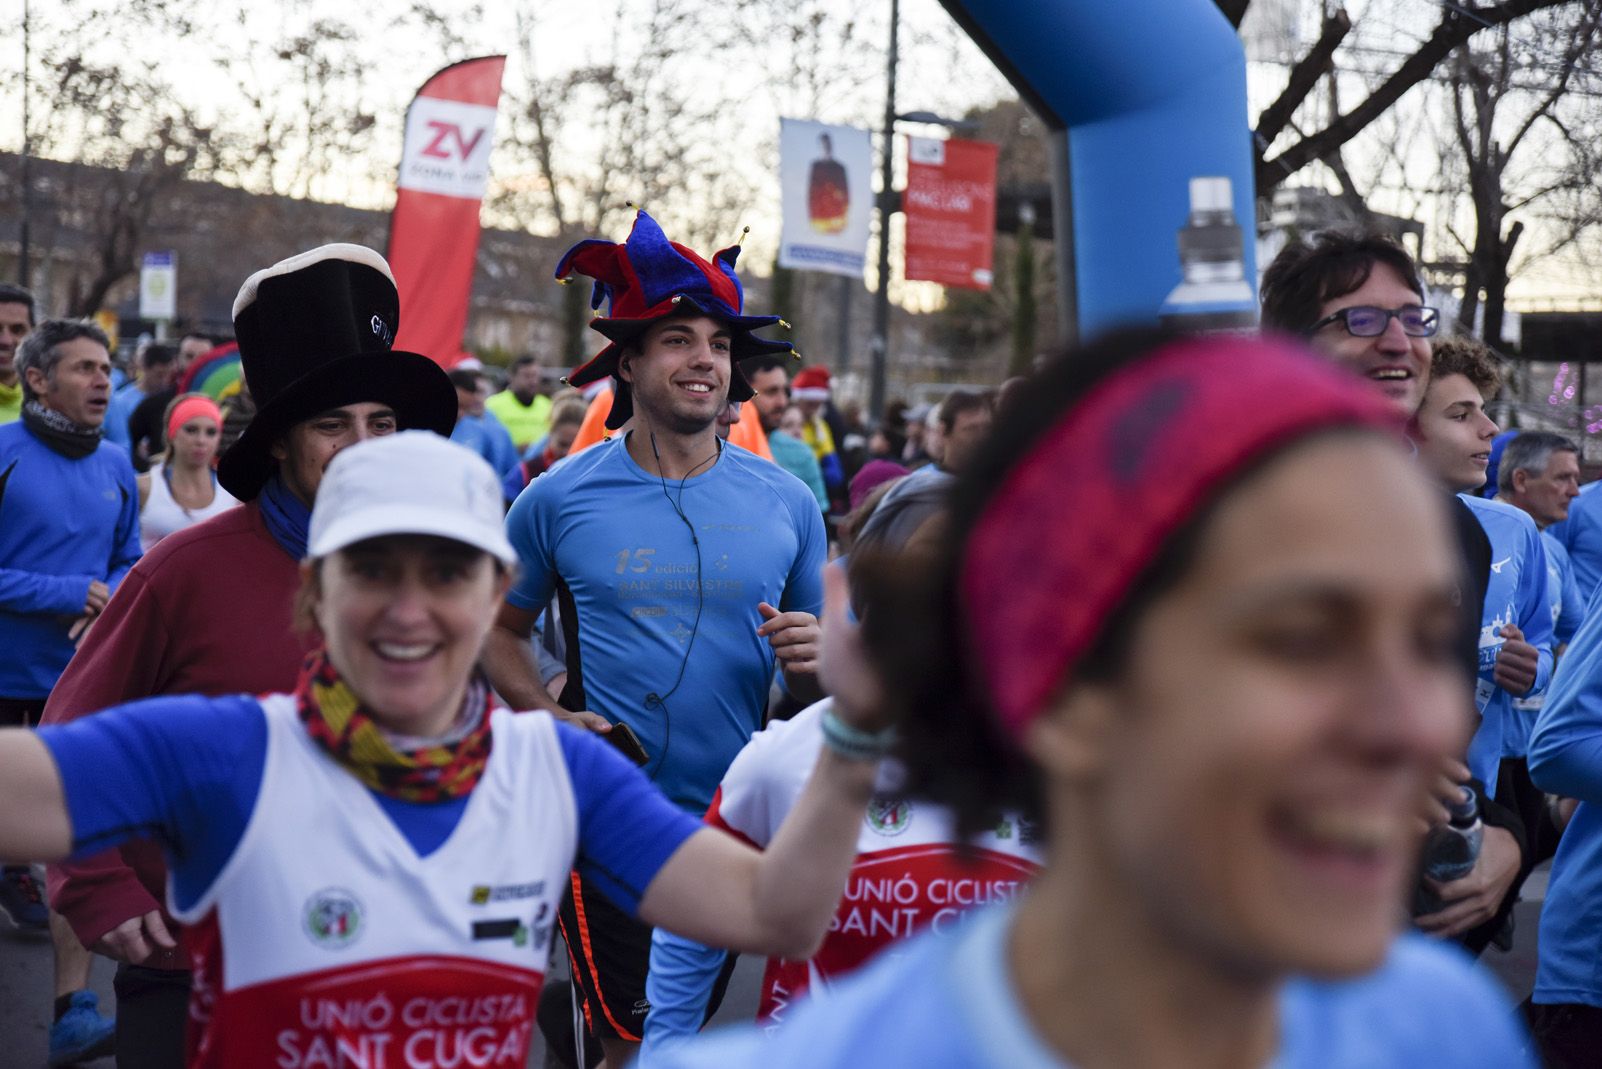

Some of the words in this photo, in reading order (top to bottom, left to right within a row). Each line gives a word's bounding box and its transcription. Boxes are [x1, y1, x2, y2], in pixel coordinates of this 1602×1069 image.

[422, 121, 485, 162] ZV
[615, 548, 656, 575] 15
[845, 872, 919, 904] UNIÓ
[300, 992, 394, 1030] UNIÓ
[401, 994, 526, 1027] CICLISTA
[276, 1029, 391, 1069] SANT
